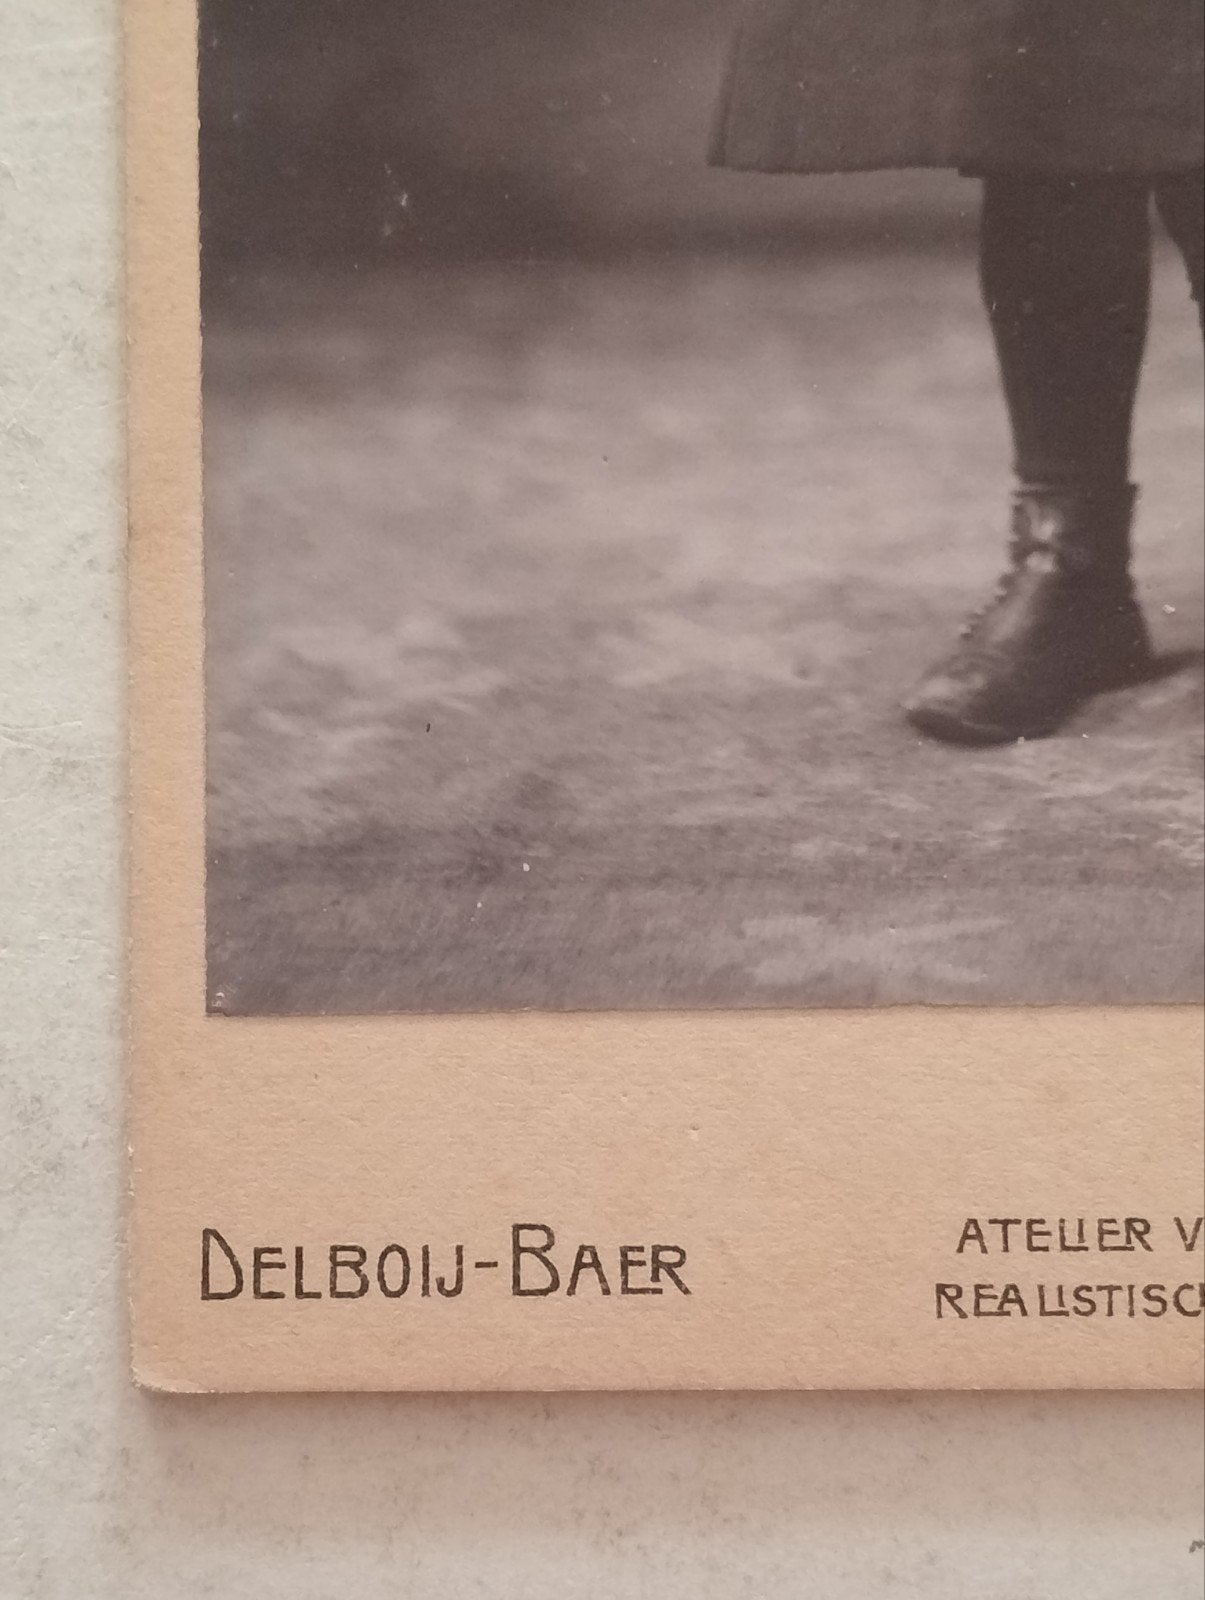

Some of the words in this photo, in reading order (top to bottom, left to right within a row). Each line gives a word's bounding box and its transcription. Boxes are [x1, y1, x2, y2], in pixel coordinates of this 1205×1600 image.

[955, 1217, 1153, 1254] ATELIER
[200, 1223, 692, 1301] DELBOIJ-BAER
[935, 1282, 1205, 1319] REALISTISC
